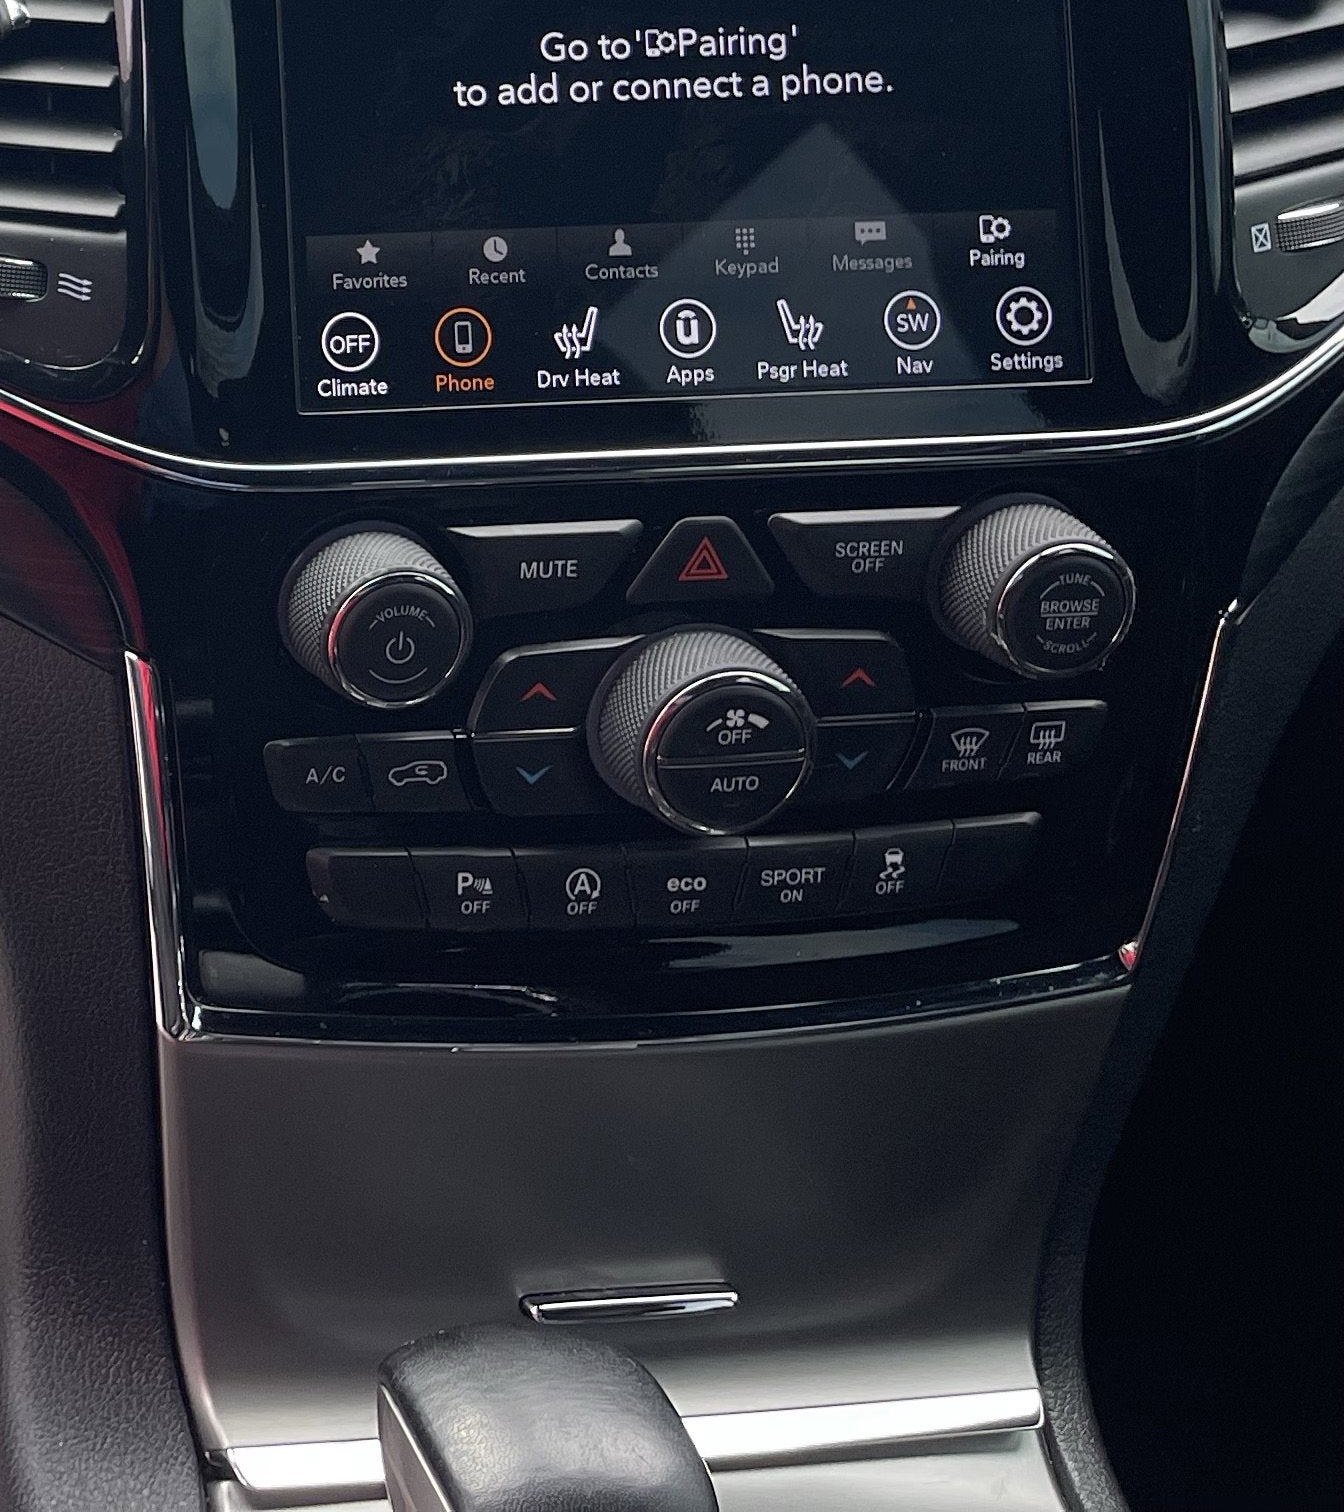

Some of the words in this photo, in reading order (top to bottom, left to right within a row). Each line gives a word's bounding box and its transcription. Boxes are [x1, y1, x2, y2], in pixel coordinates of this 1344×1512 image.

[540, 31, 589, 62] Go
[452, 80, 487, 107] to
[497, 71, 559, 106] add
[569, 80, 604, 103] or
[612, 71, 743, 102] connect
[751, 74, 770, 97] a
[781, 63, 893, 102] phone.
[715, 255, 779, 279] Keypad
[832, 254, 913, 273] Messages
[969, 248, 1025, 269] Pairing
[332, 271, 408, 290] Favorites
[468, 268, 526, 285] Recent
[585, 263, 659, 280] Contacts
[896, 312, 929, 333] SW
[329, 333, 371, 355] OFF
[757, 361, 798, 383] Psgr
[802, 359, 849, 378] Heat
[896, 356, 934, 375] Nav
[990, 351, 1064, 373] Settings
[435, 373, 495, 393] Phone
[537, 370, 570, 389] Drv
[574, 368, 621, 387] Heat
[666, 365, 715, 387] Apps
[317, 378, 389, 397] Climate
[835, 539, 904, 559] SCREEN
[520, 559, 578, 579] MUTE
[851, 557, 885, 574] OFF
[1058, 572, 1092, 586] TUNE
[375, 605, 428, 623] VOLUME
[1040, 598, 1100, 613] BROWSE
[1045, 616, 1091, 630] ENTER
[1042, 639, 1090, 654] SCROLL
[718, 728, 752, 746] OFF
[941, 757, 987, 773] FRONT
[1026, 750, 1062, 765] REAR
[305, 765, 346, 785] A/C
[710, 775, 759, 793] AUTO
[666, 876, 707, 892] eco
[760, 867, 826, 887] SPORT
[780, 888, 804, 903] ON
[875, 880, 904, 895] OFF
[460, 899, 491, 915] OFF
[566, 900, 598, 916] OFF
[670, 899, 700, 914] OFF
